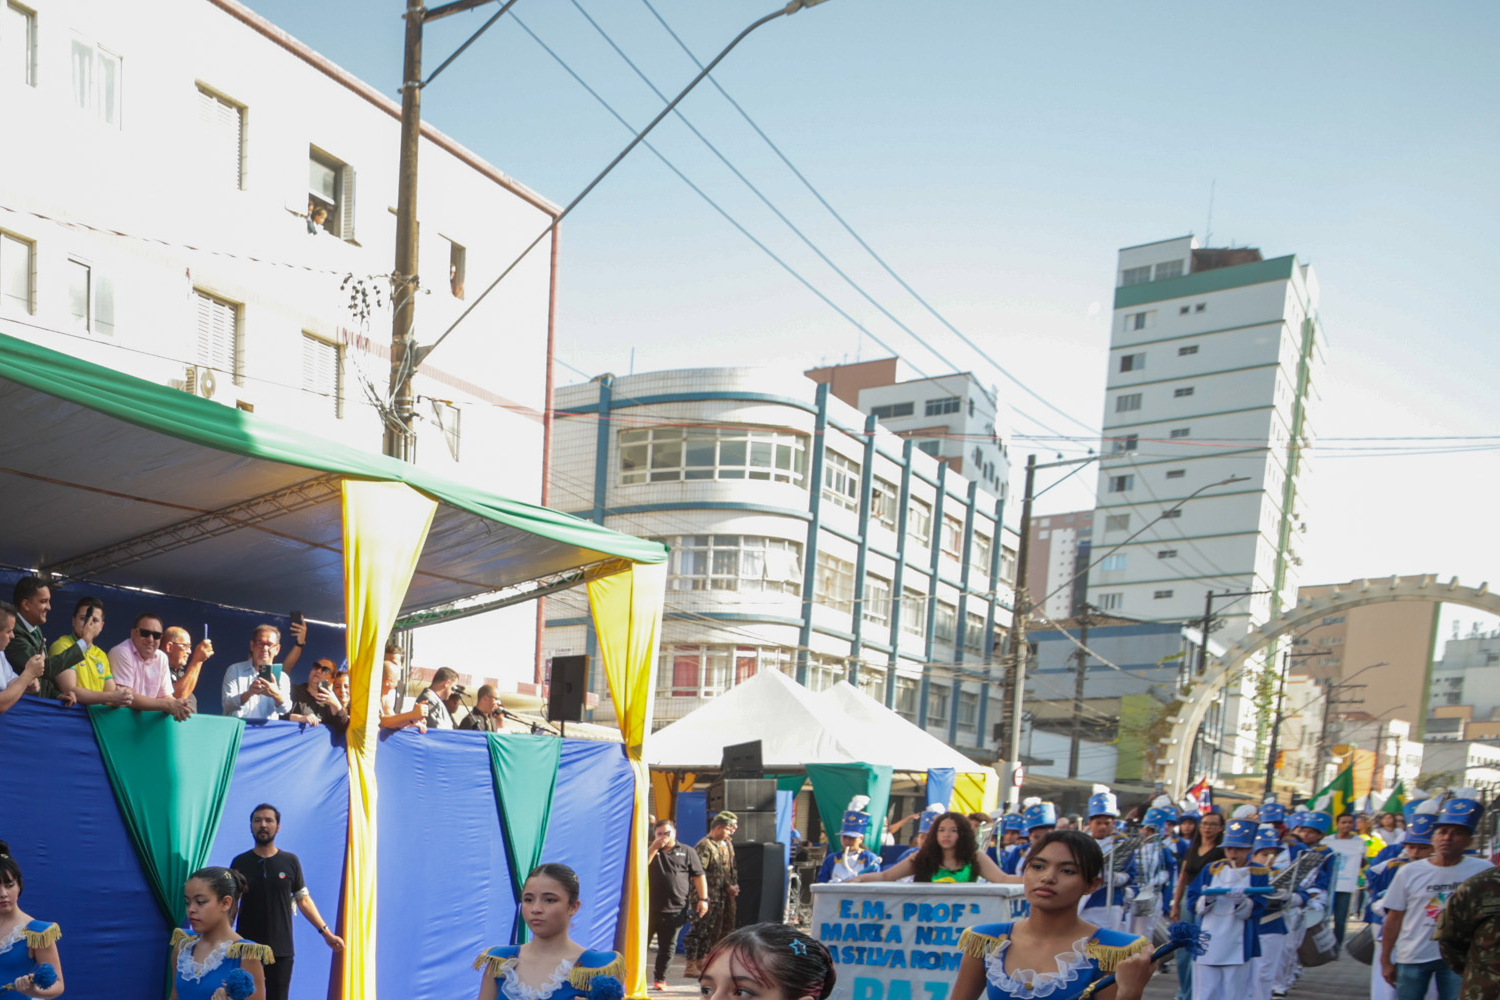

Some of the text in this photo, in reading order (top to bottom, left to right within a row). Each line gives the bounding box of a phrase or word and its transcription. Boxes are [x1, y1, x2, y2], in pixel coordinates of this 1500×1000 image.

[839, 900, 892, 920] E.M.
[820, 922, 903, 943] MARIA
[841, 945, 908, 969] SILVA
